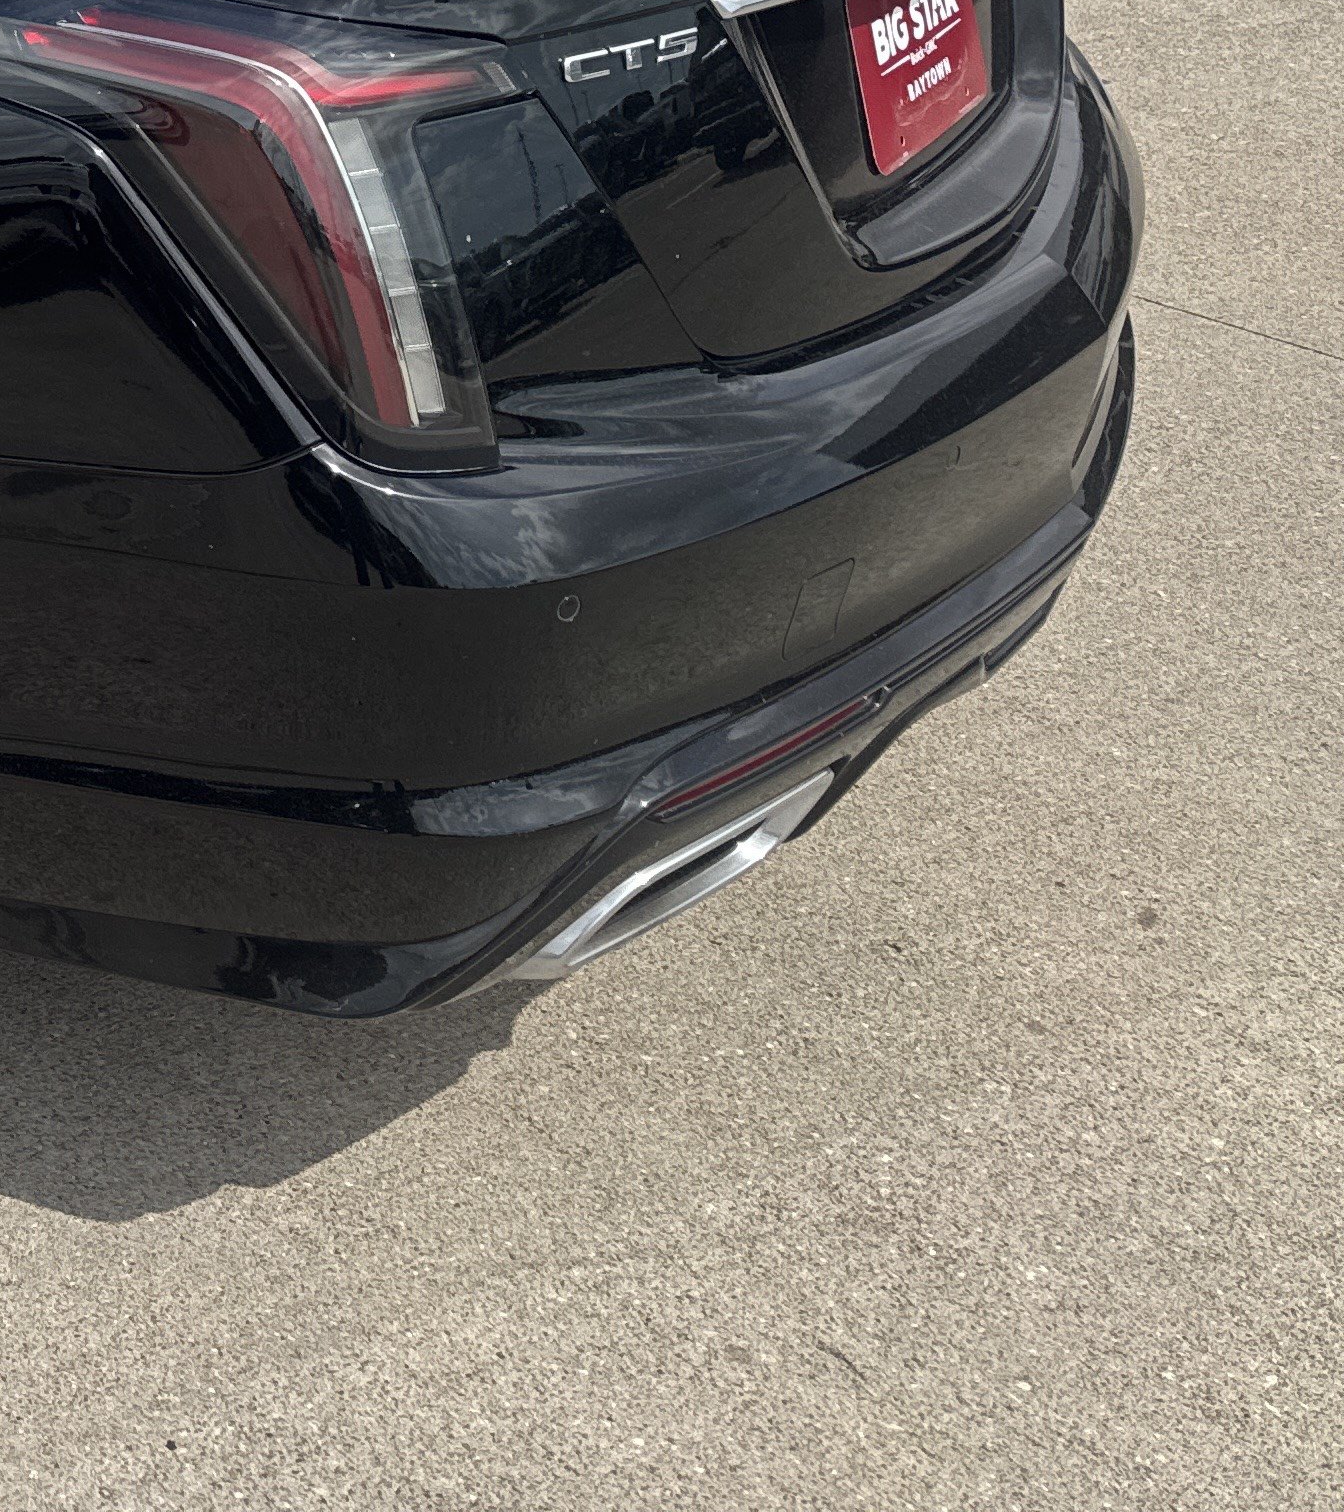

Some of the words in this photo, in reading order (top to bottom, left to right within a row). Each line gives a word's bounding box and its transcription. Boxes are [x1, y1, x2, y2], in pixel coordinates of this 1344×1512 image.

[563, 26, 699, 83] CT5
[871, 6, 910, 66] BIG
[907, 56, 952, 102] BAYTOWN
